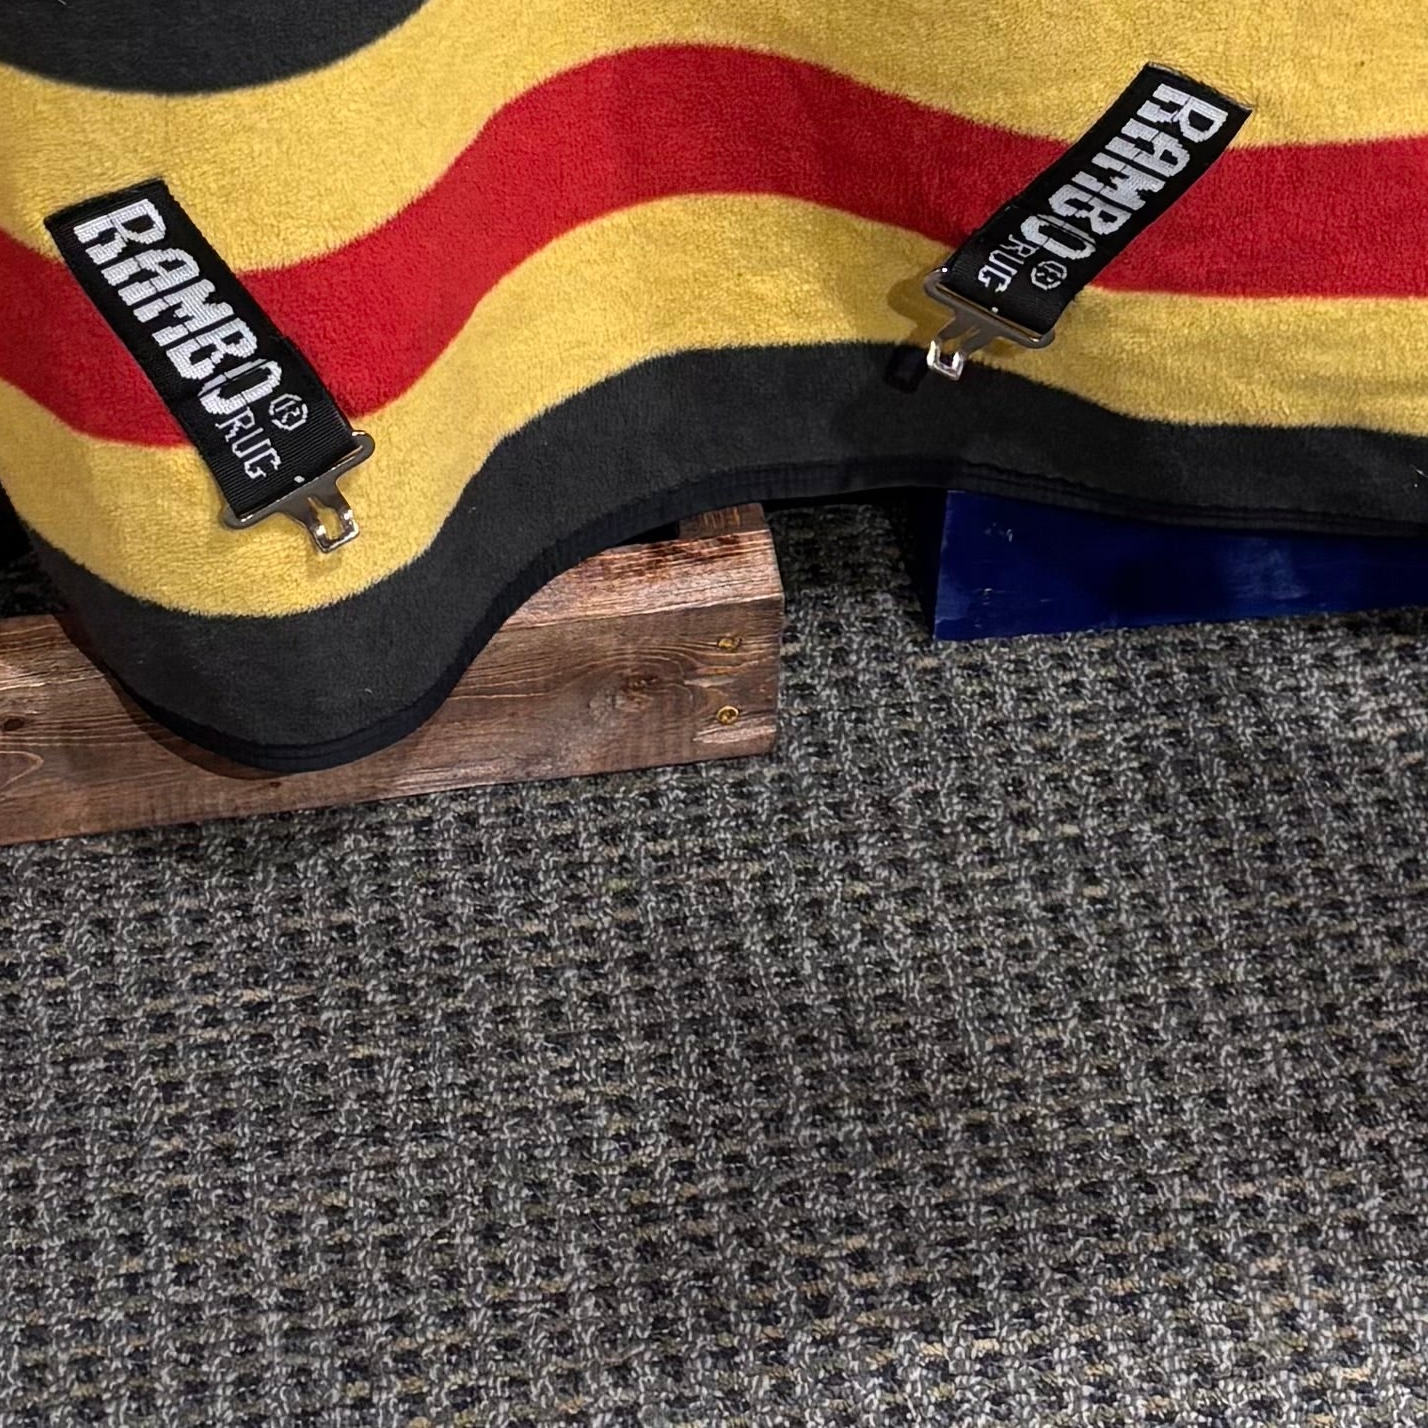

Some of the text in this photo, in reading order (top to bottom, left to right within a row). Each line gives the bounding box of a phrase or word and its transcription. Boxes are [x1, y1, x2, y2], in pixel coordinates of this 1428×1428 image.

[1020, 82, 1230, 260] RAMBO
[72, 197, 283, 415] RAMBO
[977, 233, 1041, 294] RUG
[214, 406, 282, 480] RUG
